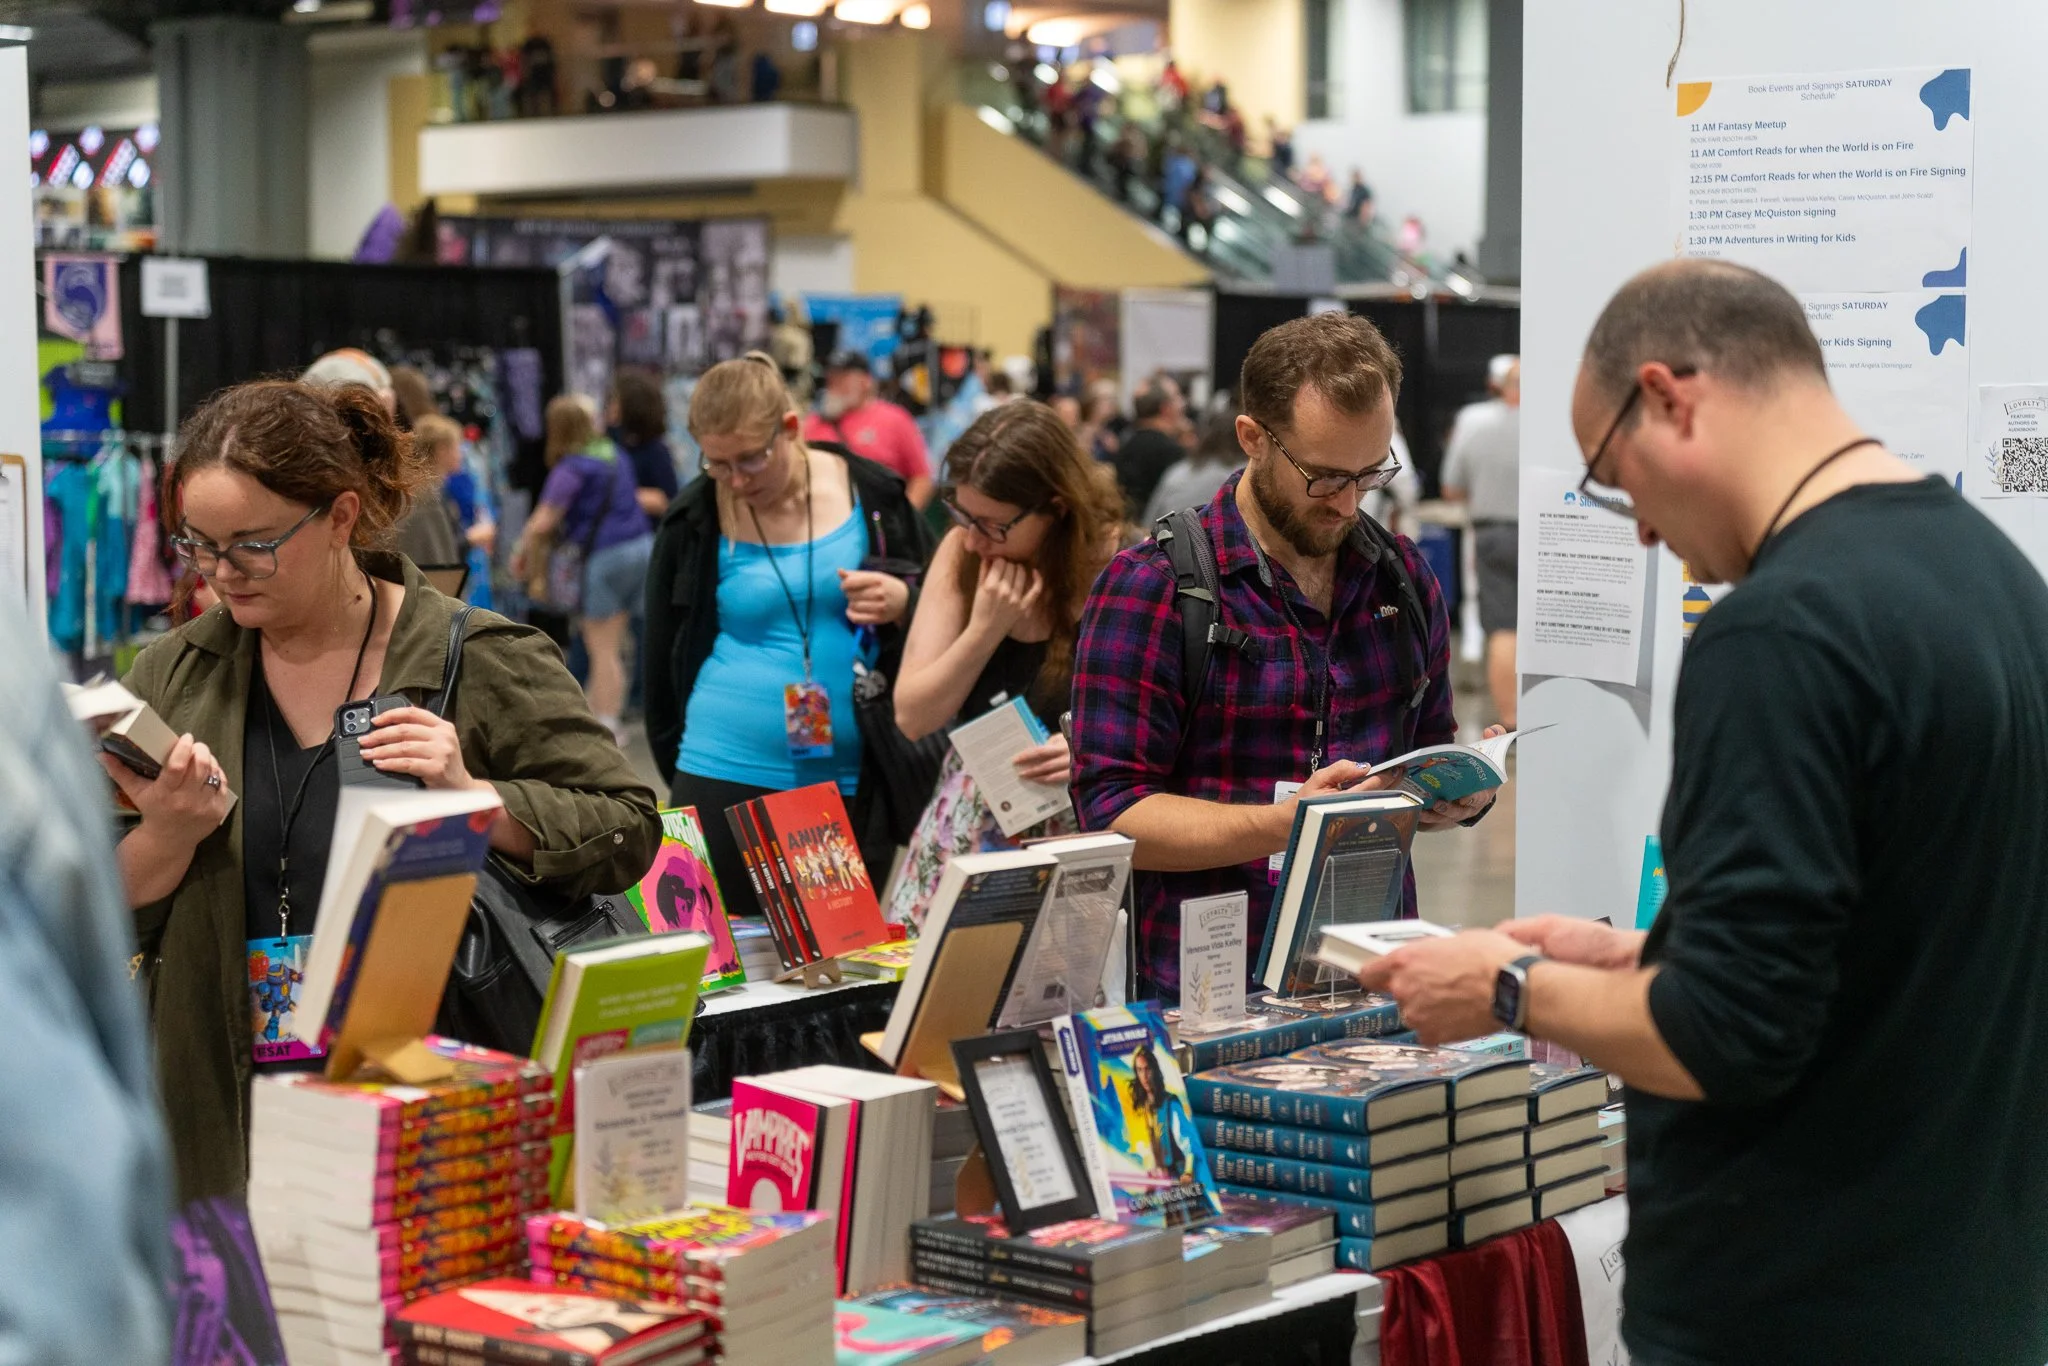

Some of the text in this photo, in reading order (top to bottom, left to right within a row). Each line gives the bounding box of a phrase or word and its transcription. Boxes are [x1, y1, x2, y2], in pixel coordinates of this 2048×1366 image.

[1748, 79, 1892, 94] Book Events and Signings SATURDAY
[1691, 121, 1787, 134] 11 AM Fantasy Meetup
[1690, 150, 1700, 158] 11
[1702, 149, 1716, 157] AM
[1718, 148, 1753, 156] Comfort
[1756, 146, 1782, 155] Reads
[1785, 146, 1796, 154] for
[1800, 144, 1823, 154] when
[1826, 144, 1840, 152] the
[1842, 142, 1869, 152] World
[1872, 142, 1880, 150] is
[1896, 141, 1914, 150] Fire
[1690, 175, 1712, 184] 12:15
[1715, 174, 1728, 182] PM
[1730, 174, 1766, 182] Comfort
[1768, 172, 1796, 181] Reads
[1798, 172, 1810, 180] for
[1812, 171, 1836, 180] when
[1839, 170, 1853, 179] the
[1856, 169, 1882, 178] World
[1885, 168, 1893, 177] is
[1910, 168, 1928, 176] Fire
[1930, 166, 1966, 178] Signing
[1690, 208, 1836, 220] 1:30 PM Casey McQuiston signing
[1689, 233, 1856, 245] 1:30 PM Adventures in Writing for Kids
[1808, 302, 1840, 312] Signings
[1842, 302, 1888, 310] SATURDAY
[1820, 338, 1892, 348] for Kids Signing
[2009, 400, 2040, 410] LOYALTY
[787, 822, 843, 851] ANIME
[762, 867, 775, 890] HISTORY
[779, 862, 792, 884] HISTORY
[750, 872, 763, 894] HISTORY
[1203, 908, 1228, 921] LOYALTY
[1186, 938, 1242, 954] Venessa Vida Kelley
[1124, 1028, 1147, 1041] WARS
[1213, 1088, 1222, 1113] WHEN
[1216, 1120, 1225, 1147] WHEN
[1216, 1153, 1225, 1179] WHEN
[1129, 1184, 1202, 1210] CONVERGENCE
